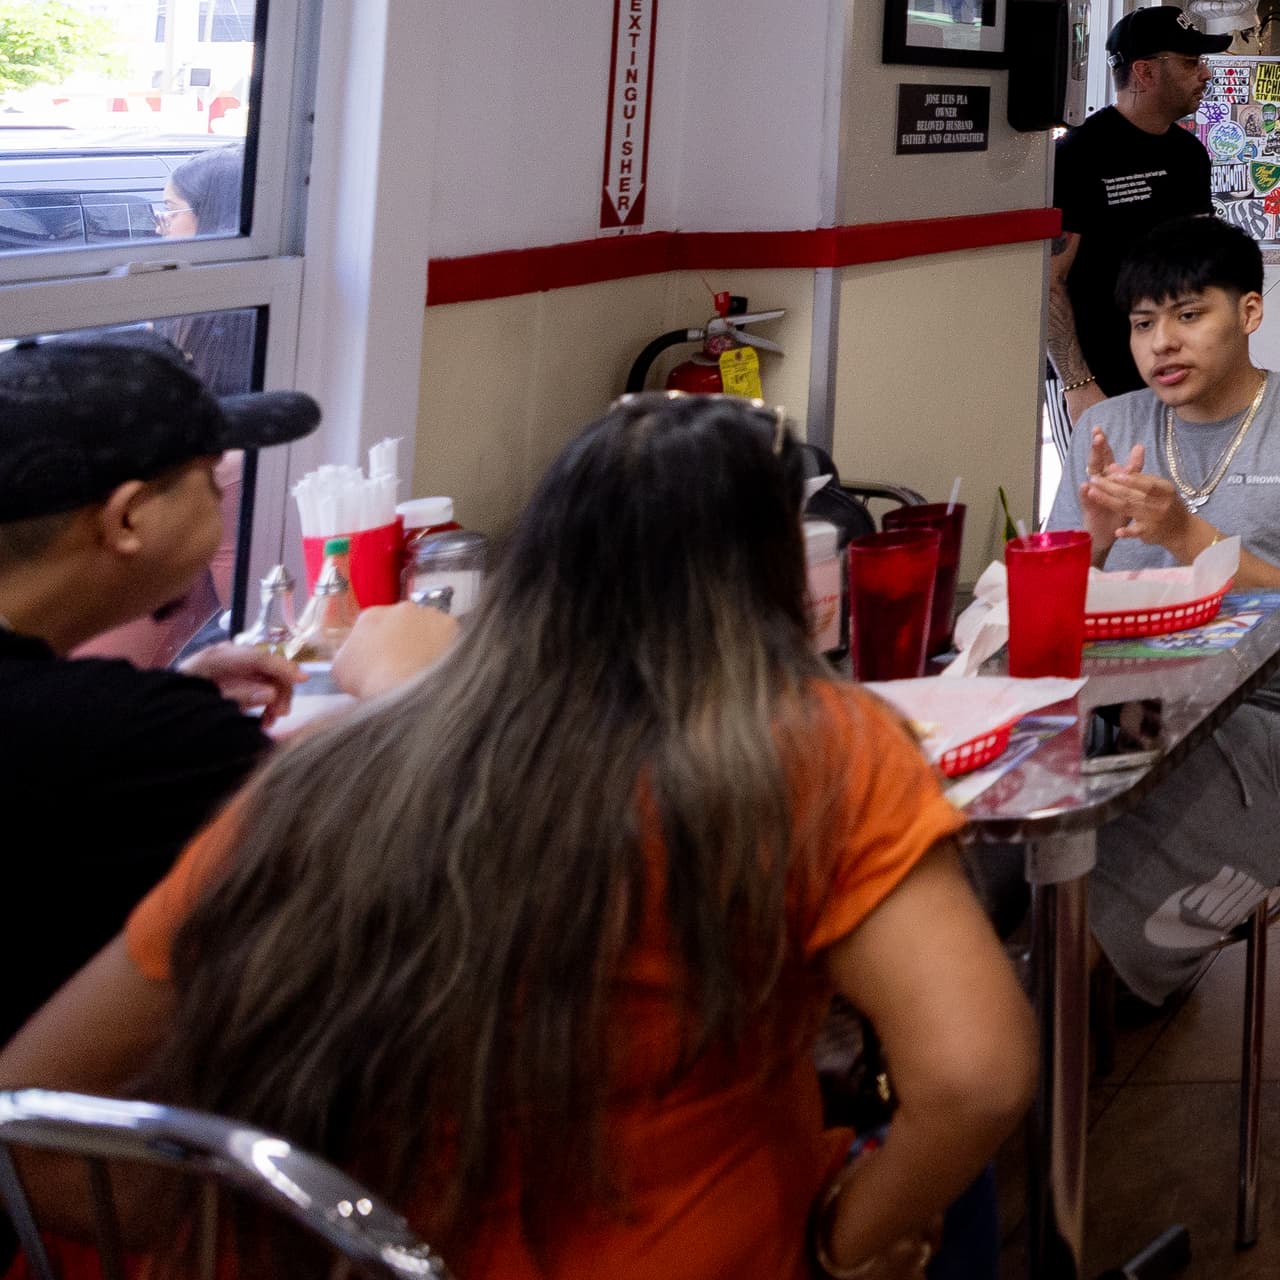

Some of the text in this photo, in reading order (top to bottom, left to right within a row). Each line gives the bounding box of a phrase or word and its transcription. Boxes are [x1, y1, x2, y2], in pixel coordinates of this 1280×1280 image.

[924, 94, 968, 106] JOSE LUIS PLA
[936, 107, 958, 118] OWNER
[916, 120, 974, 131] BELOVED HUSBAND
[902, 133, 984, 144] FATHER AND GRANDFATHER
